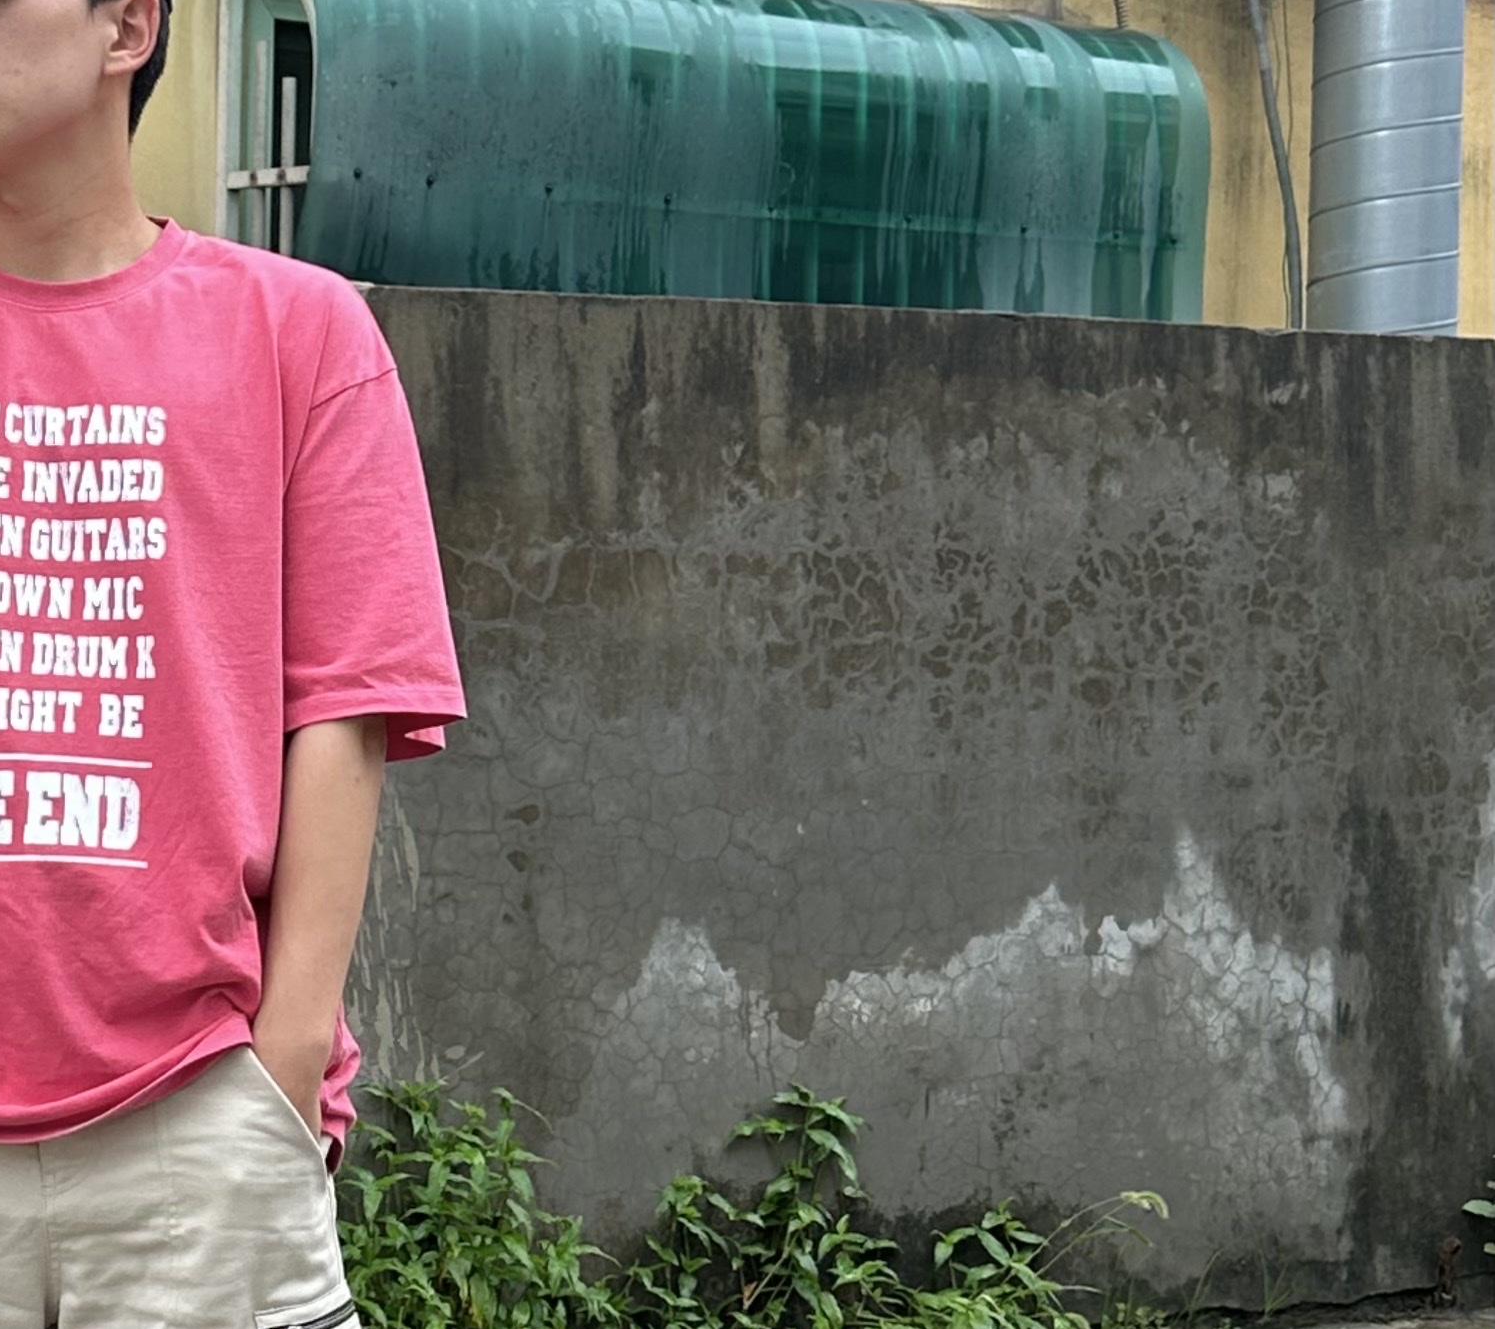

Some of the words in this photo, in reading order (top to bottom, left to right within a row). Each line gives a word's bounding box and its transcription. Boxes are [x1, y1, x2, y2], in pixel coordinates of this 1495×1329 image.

[4, 403, 167, 447] CURTAINS
[21, 459, 164, 504] INVADED
[29, 516, 168, 562] GUITARS
[82, 576, 144, 621] MIC
[31, 632, 129, 680] DRUM
[98, 693, 144, 739] BE
[23, 770, 141, 851] END
